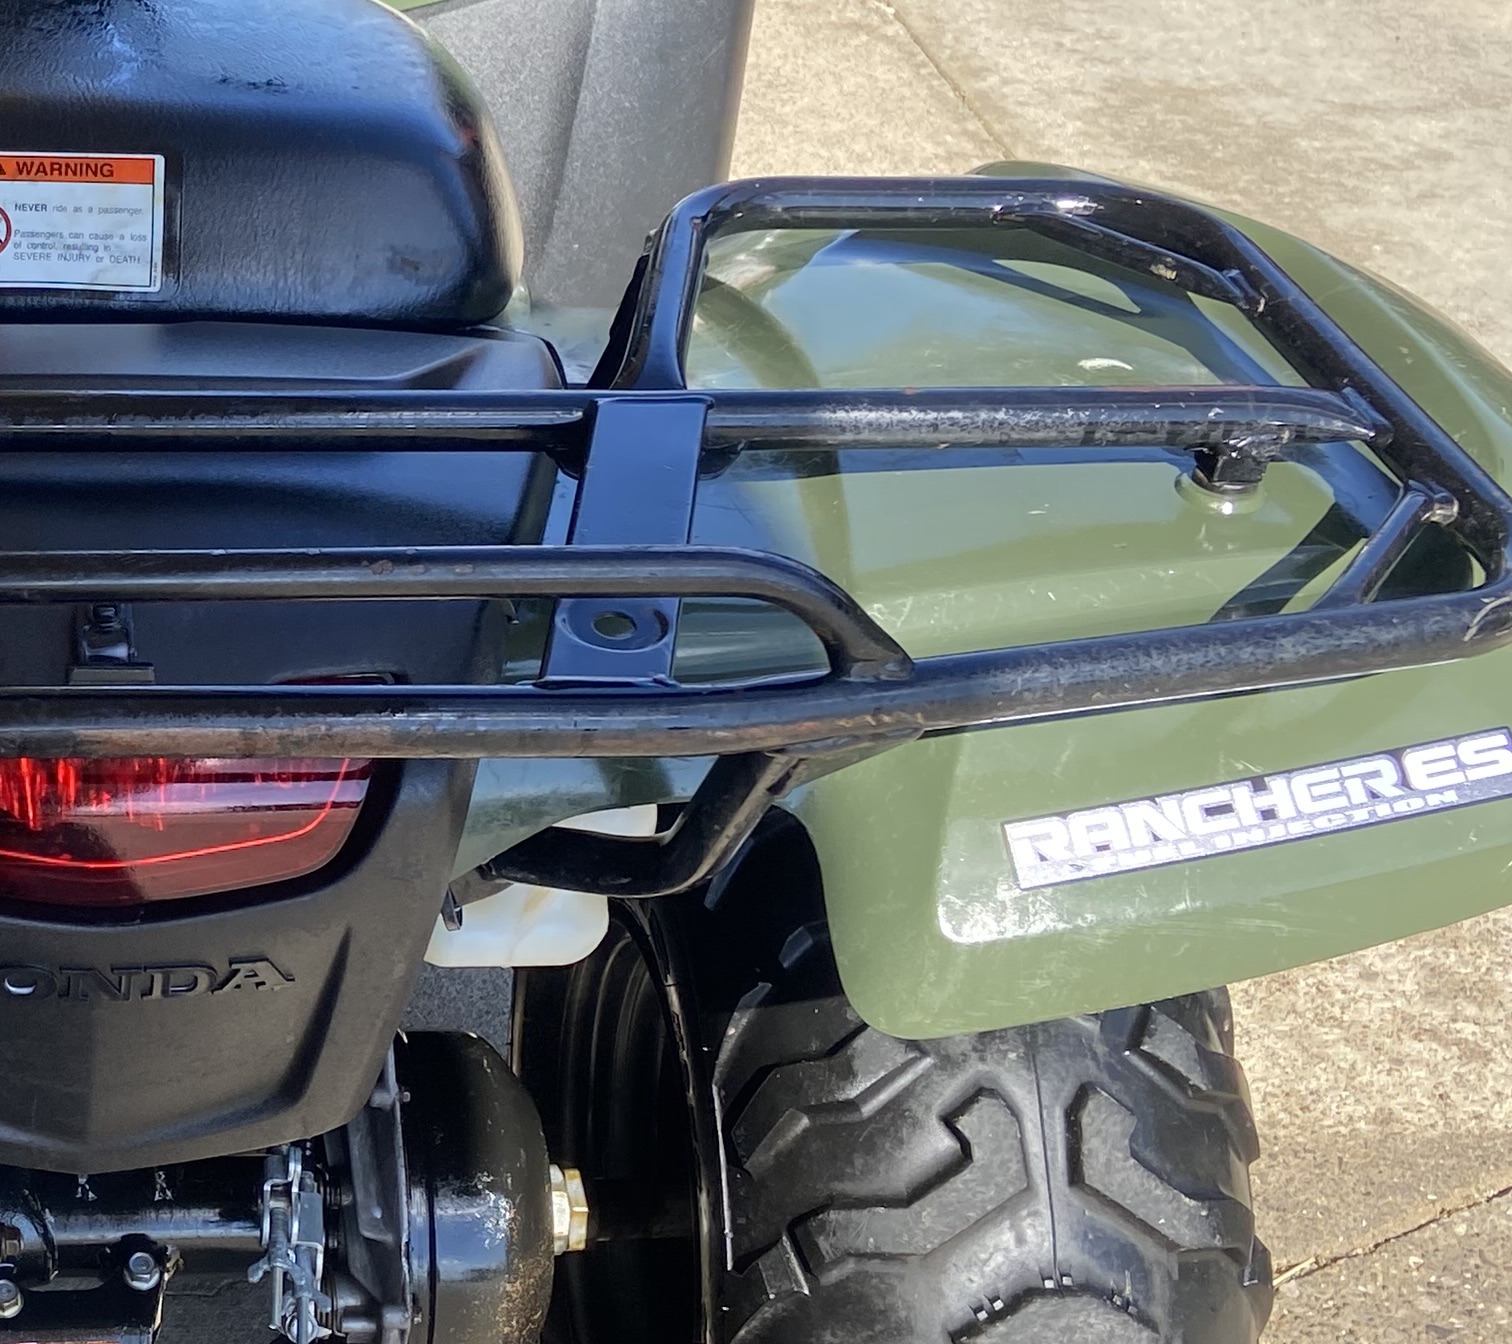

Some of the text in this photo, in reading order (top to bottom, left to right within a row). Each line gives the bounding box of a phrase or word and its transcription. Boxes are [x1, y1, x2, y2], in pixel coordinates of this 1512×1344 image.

[16, 161, 114, 177] WARNING
[14, 204, 47, 212] NEVER
[14, 230, 64, 240] Passengers
[130, 233, 147, 241] loss
[63, 243, 99, 253] resulting
[14, 252, 52, 261] SEVERE
[58, 253, 91, 262] INJURY
[1004, 733, 1512, 864] RANCHER ES
[1216, 788, 1460, 848] INJECTION
